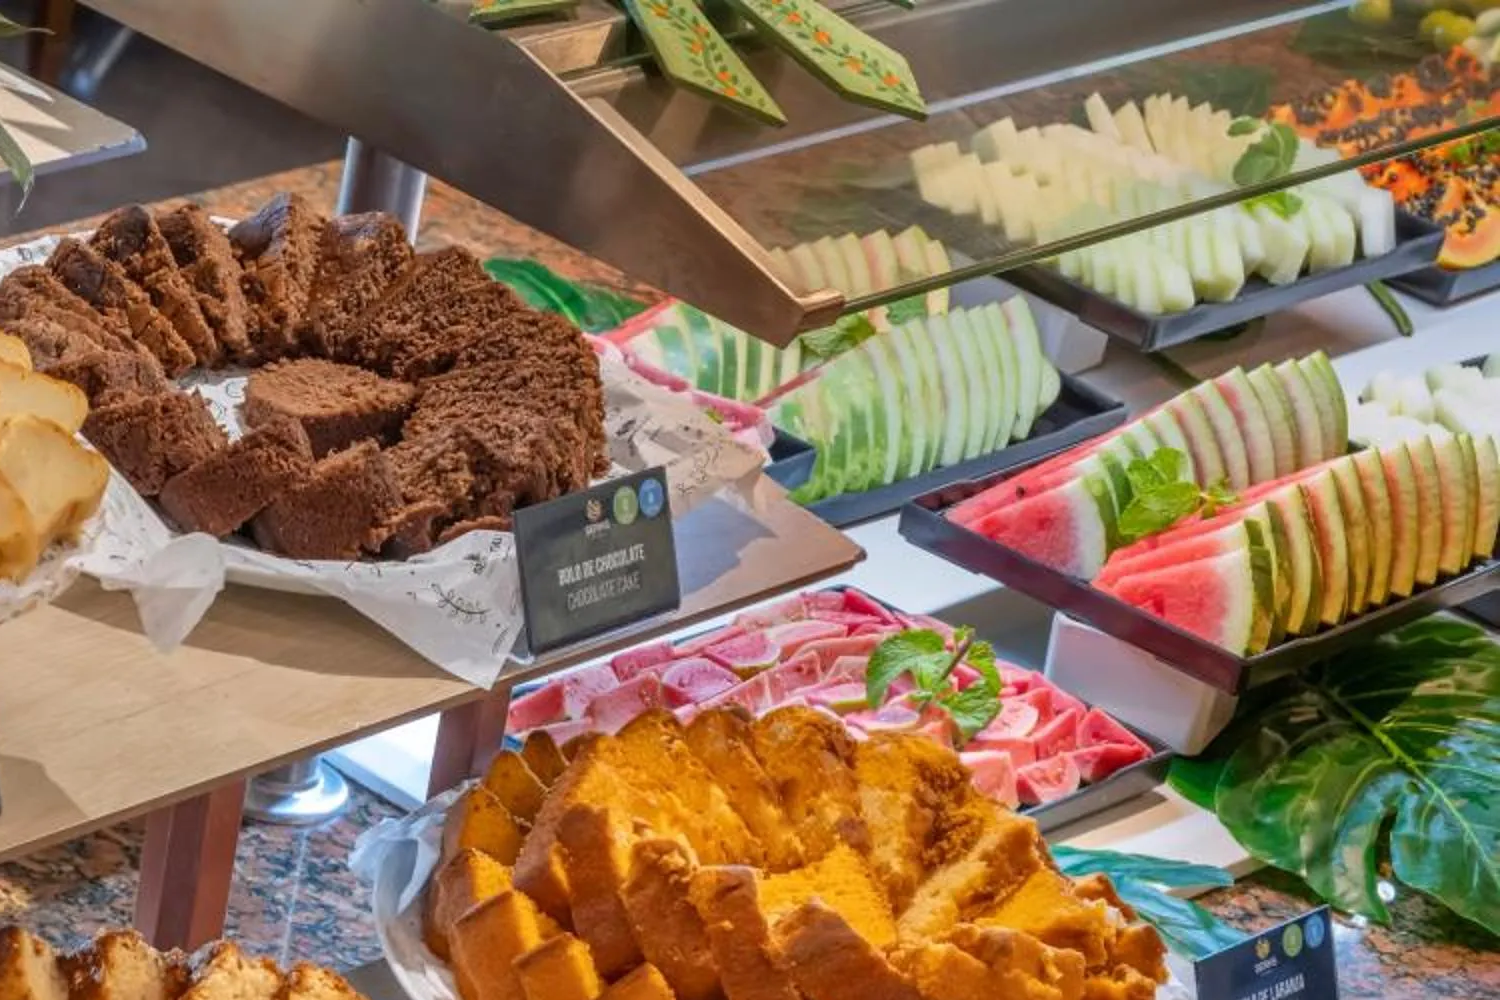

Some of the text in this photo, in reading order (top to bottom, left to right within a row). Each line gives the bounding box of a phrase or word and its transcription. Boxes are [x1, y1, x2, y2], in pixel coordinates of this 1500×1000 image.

[558, 543, 646, 586] BOLO DE CHOCOLATE
[567, 571, 641, 611] CHOCOLATE CAKE
